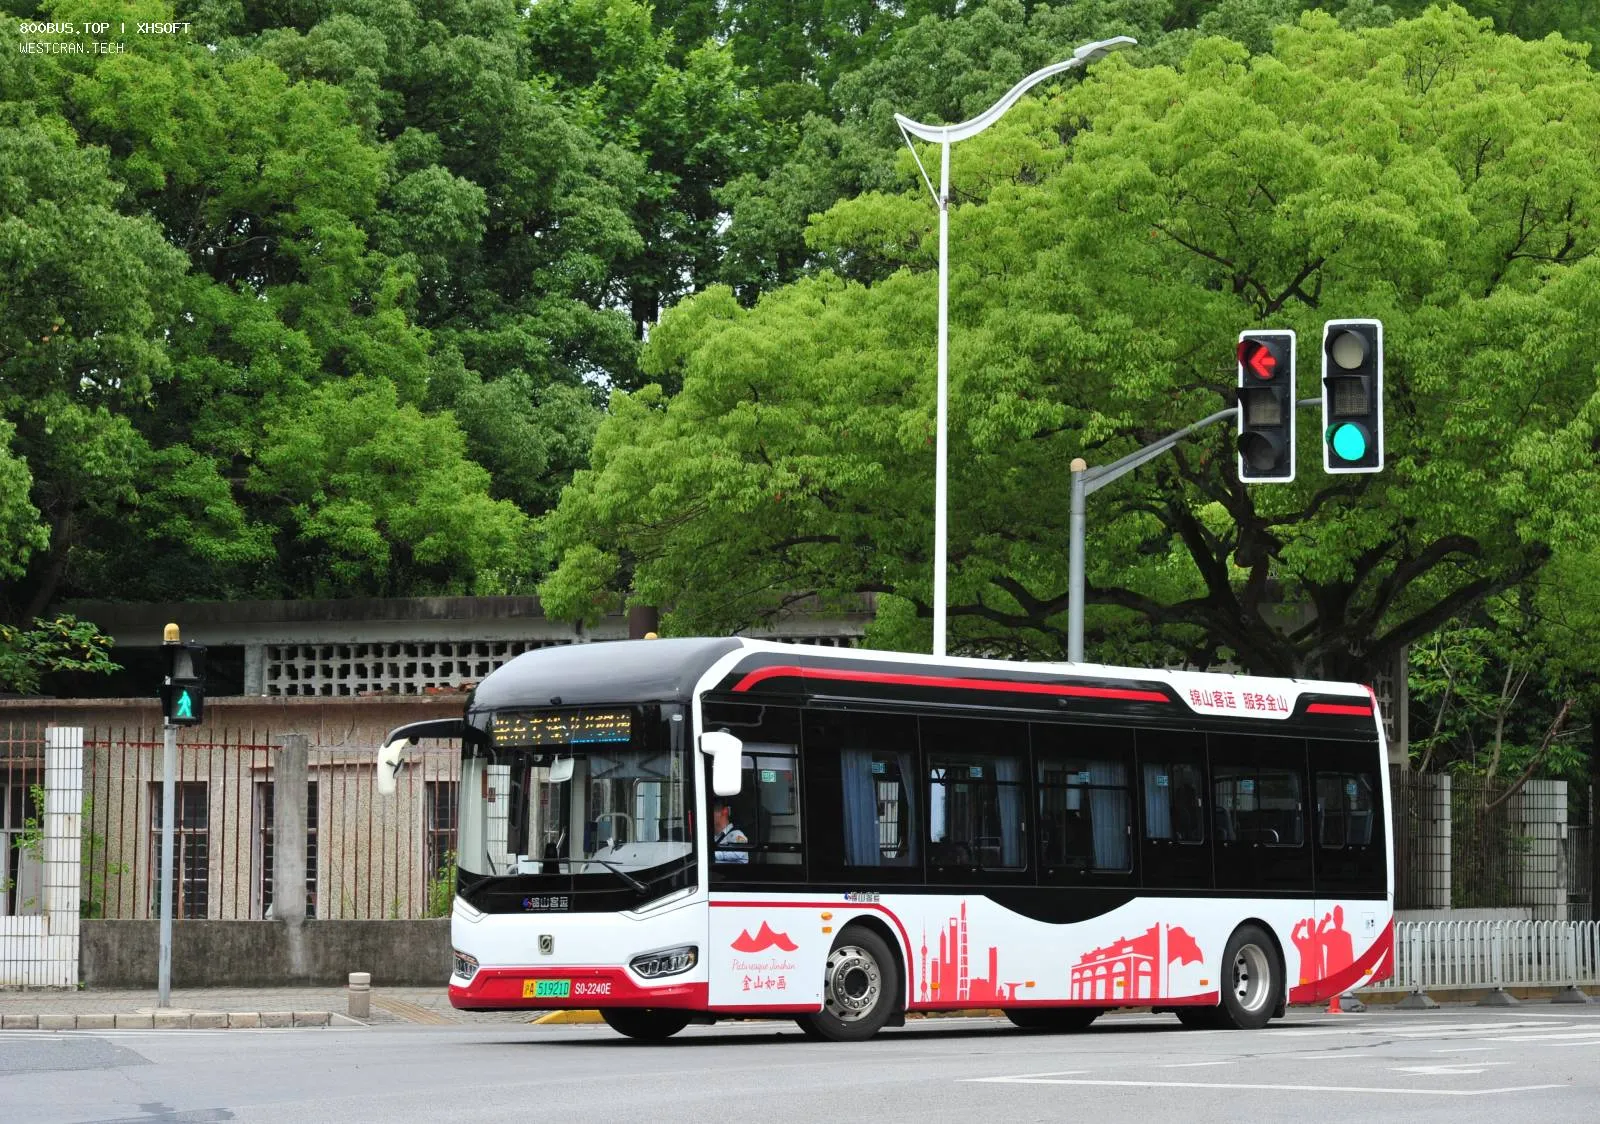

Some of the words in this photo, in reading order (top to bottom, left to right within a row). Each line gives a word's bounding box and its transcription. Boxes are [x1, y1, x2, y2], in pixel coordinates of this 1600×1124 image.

[1189, 689, 1237, 709] 锦山客运
[1242, 692, 1289, 712] 服务金山
[742, 974, 787, 991] 金山如画
